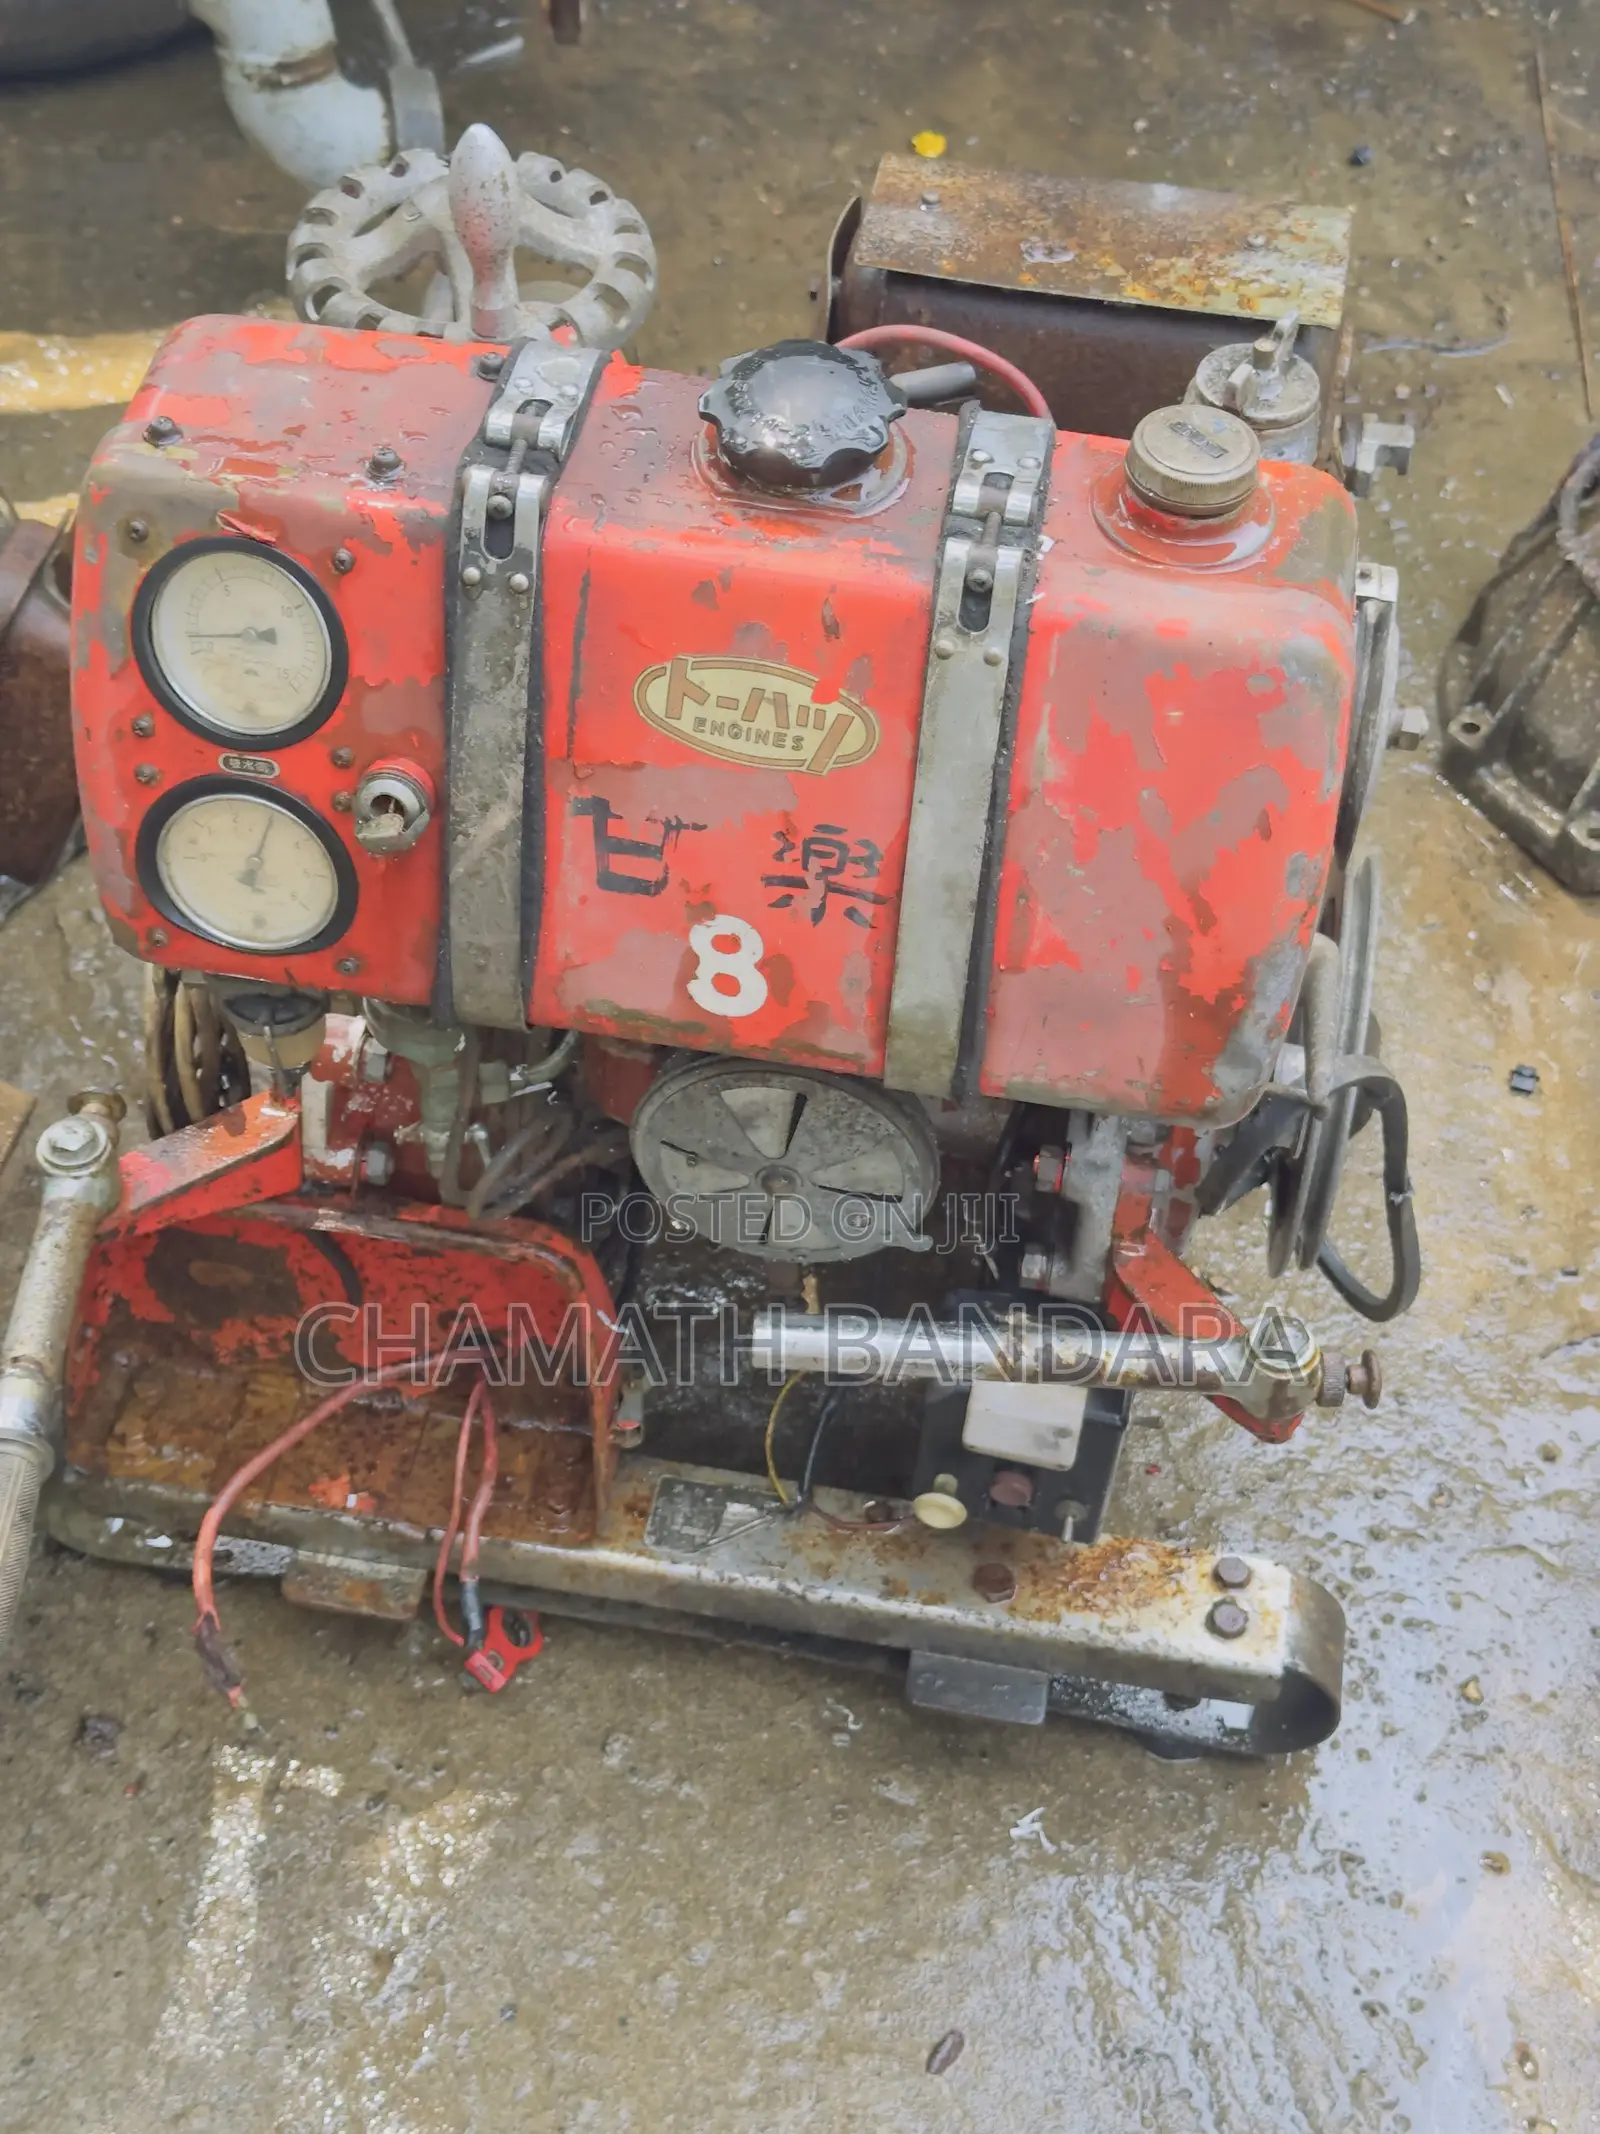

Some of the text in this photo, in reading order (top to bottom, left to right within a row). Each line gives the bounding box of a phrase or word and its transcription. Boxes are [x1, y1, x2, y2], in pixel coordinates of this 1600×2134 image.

[280, 605, 293, 618] 10
[666, 658, 855, 773] トーハツ
[693, 716, 805, 752] ENGINES
[687, 914, 769, 1018] 8
